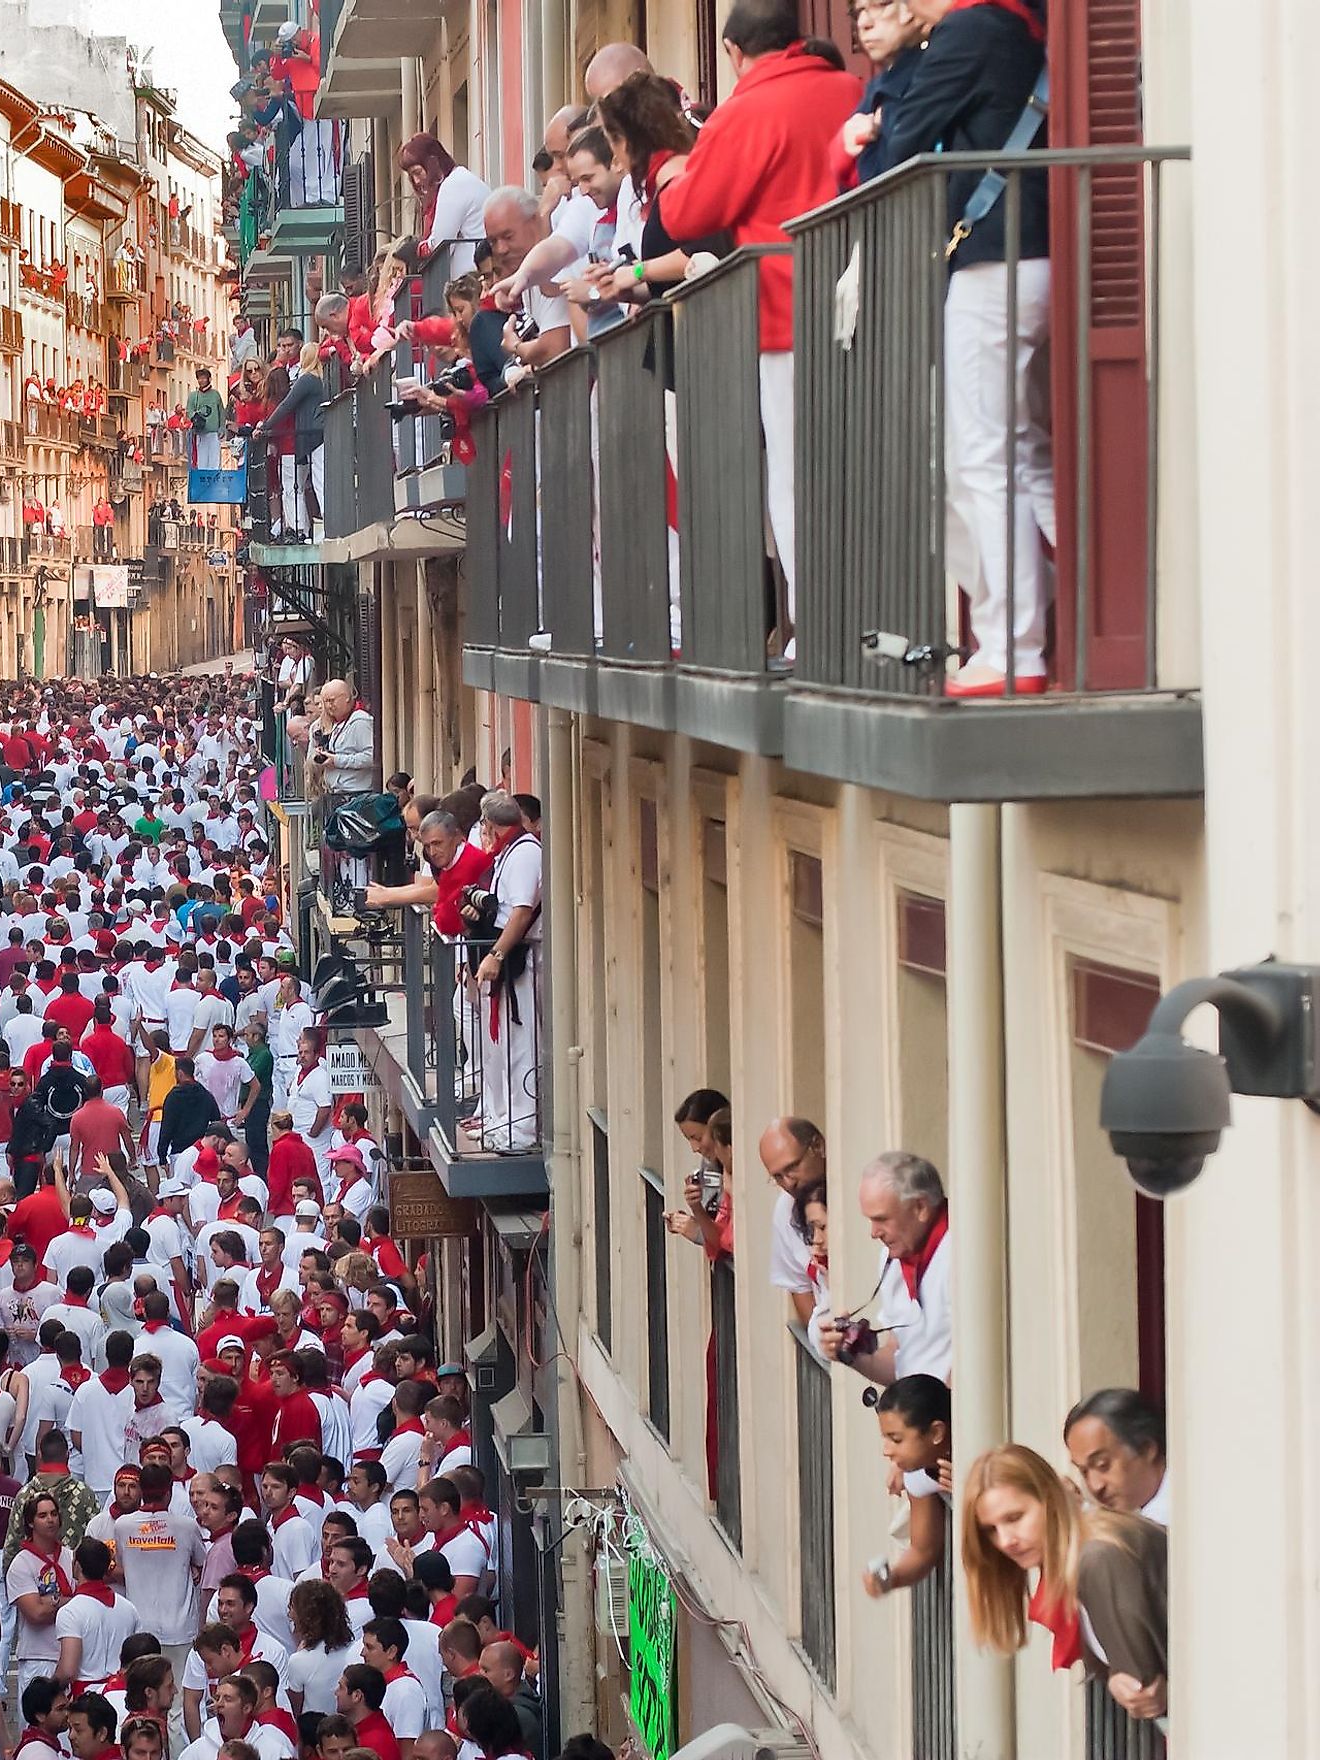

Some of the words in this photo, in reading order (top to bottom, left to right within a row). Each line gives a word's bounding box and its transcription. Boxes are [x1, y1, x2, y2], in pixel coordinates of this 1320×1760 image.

[331, 1052, 356, 1069] AMADO
[331, 1074, 355, 1087] MARCOS
[356, 1074, 361, 1086] Y
